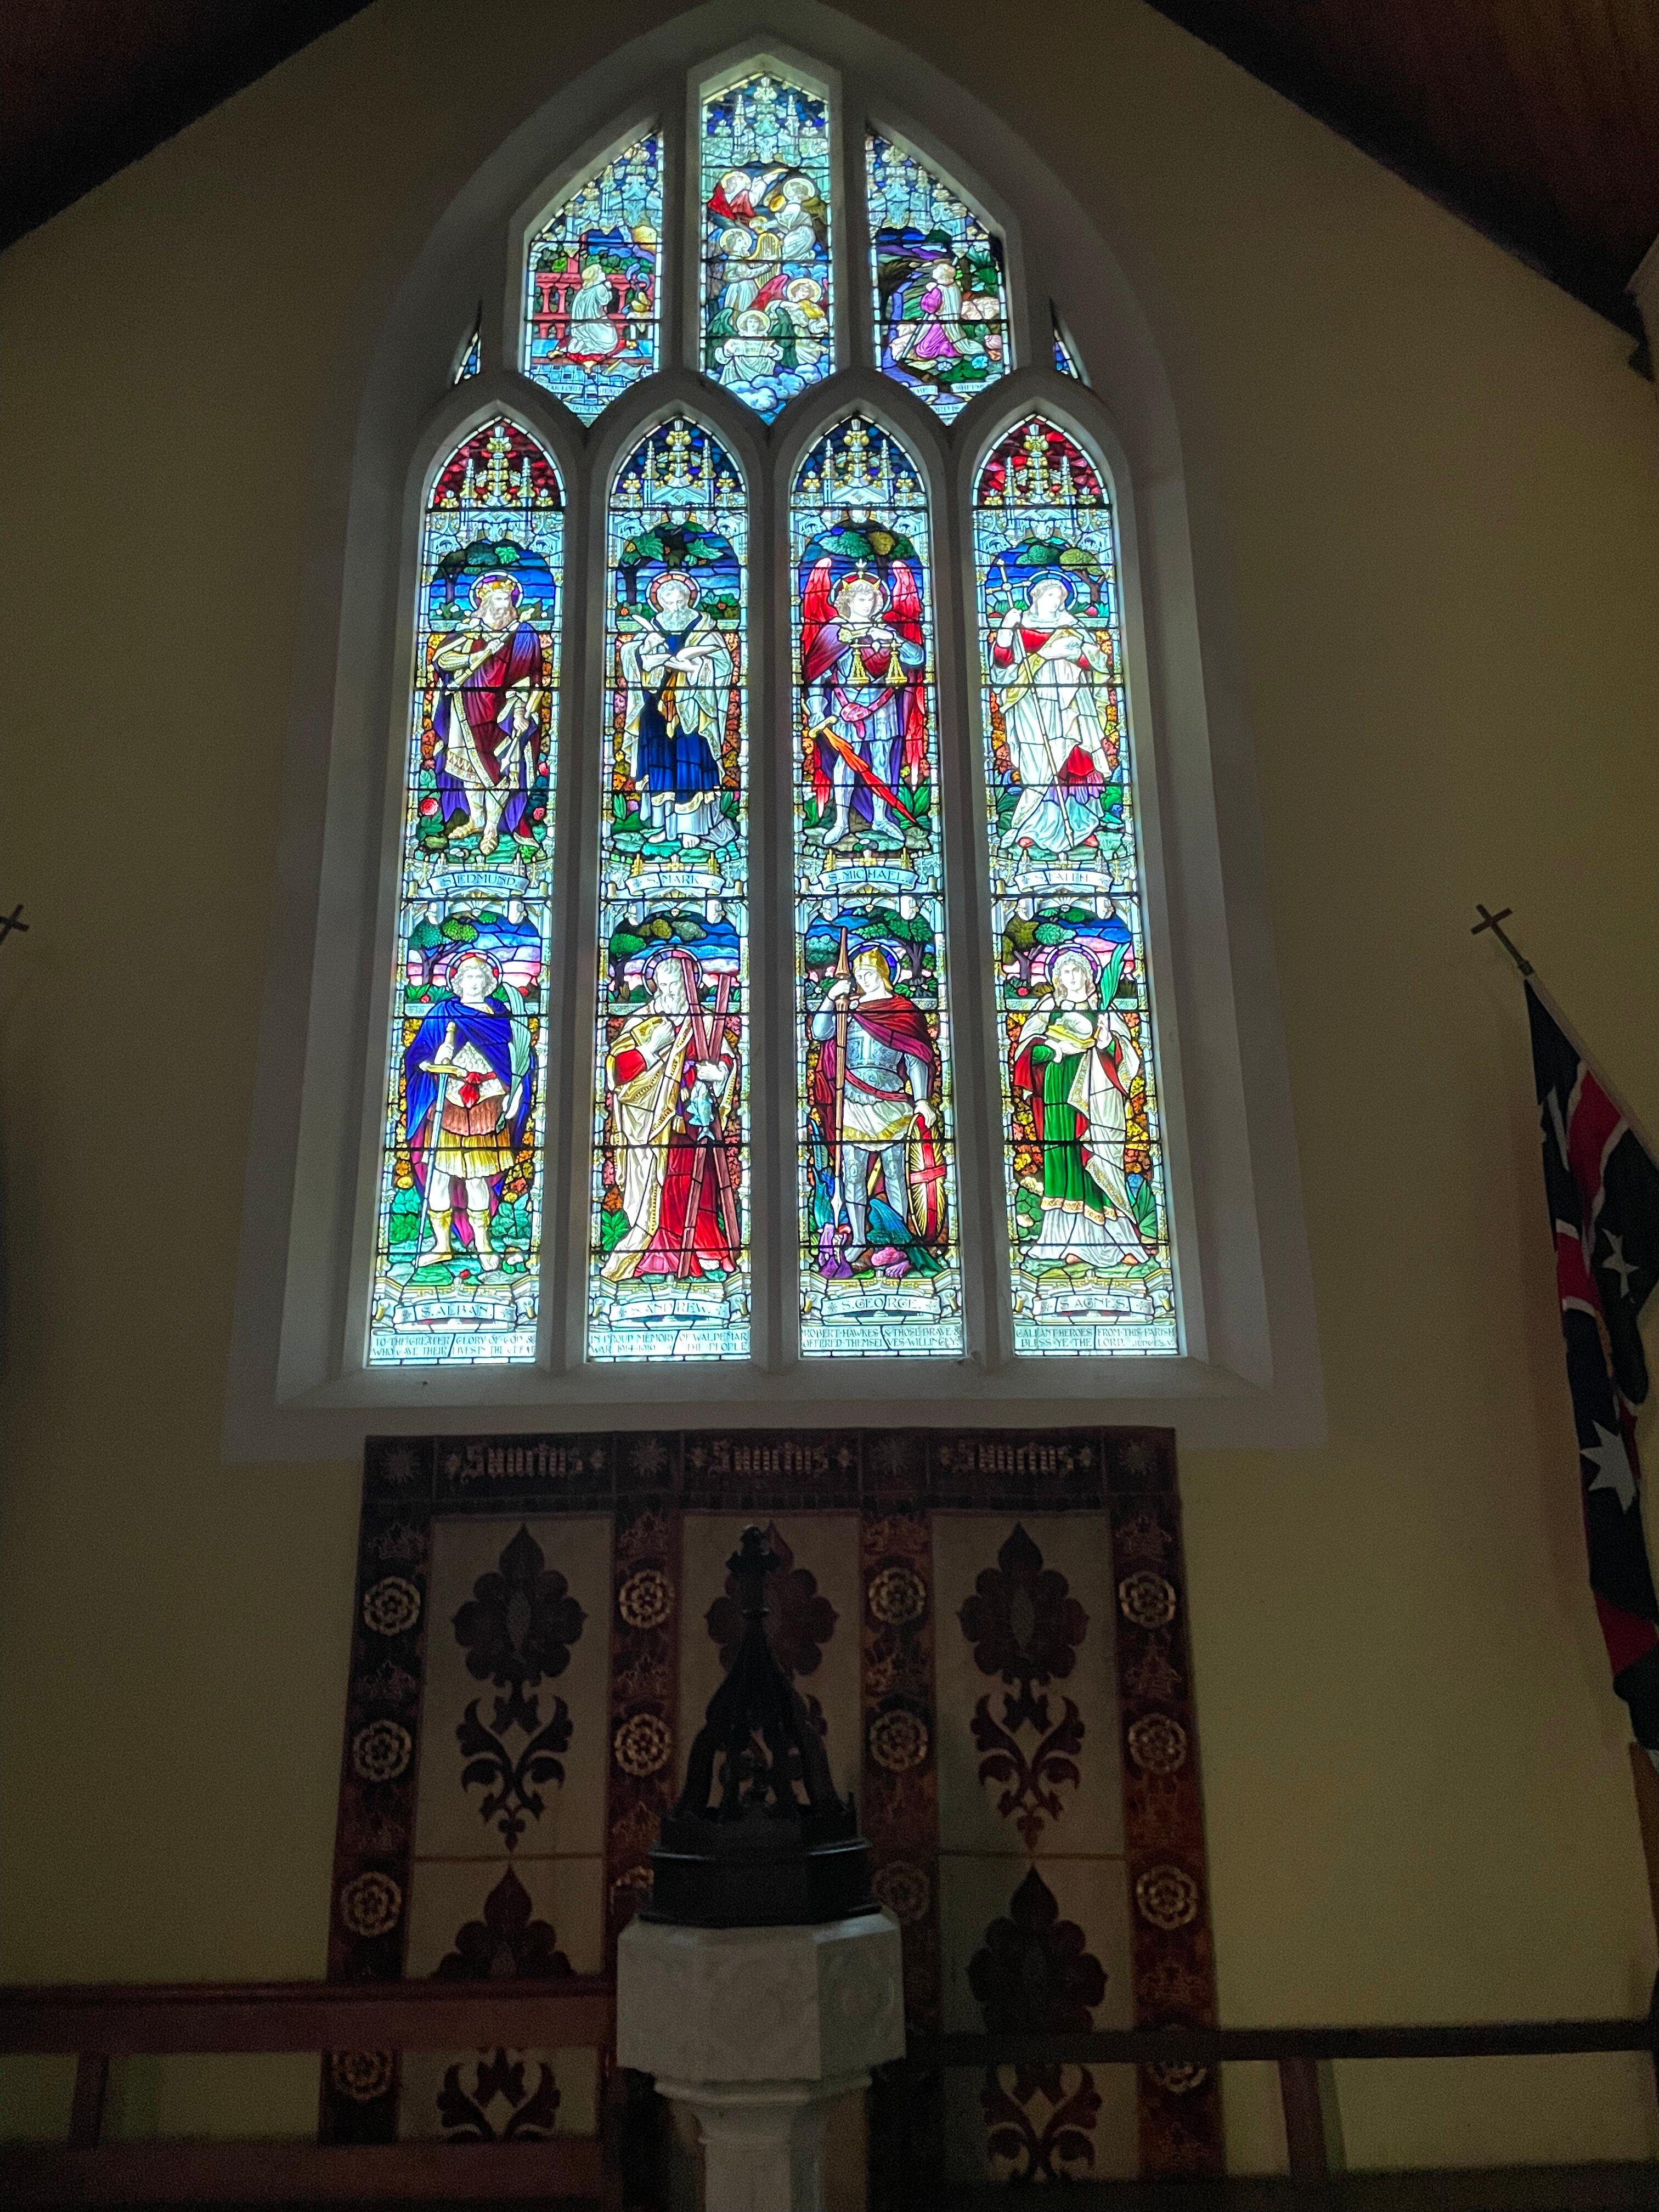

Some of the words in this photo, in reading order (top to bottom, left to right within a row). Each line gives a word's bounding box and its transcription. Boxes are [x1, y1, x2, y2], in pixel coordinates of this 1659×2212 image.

[458, 873, 518, 887] EDMUND.
[828, 873, 840, 882] S.
[842, 869, 908, 882] MICHAEL.
[645, 1302, 710, 1314] ANDREW.
[855, 1298, 921, 1310] GEORGE.
[1075, 1297, 1128, 1308] AGNES.
[436, 1305, 493, 1316] ALBAN.
[804, 1328, 839, 1338] ROBERT
[843, 1328, 879, 1337] HAWKES
[883, 1328, 891, 1337] &
[893, 1328, 919, 1336] THOSE
[923, 1327, 951, 1336] BRAVE
[953, 1327, 961, 1336] &
[1015, 1328, 1056, 1338] GALLANT
[1058, 1328, 1092, 1337] HEROES
[1097, 1328, 1120, 1337] FROM
[1122, 1328, 1142, 1336] THIS
[1144, 1327, 1175, 1336] PARISH
[376, 1337, 386, 1346] TO
[390, 1336, 405, 1345] THE
[409, 1335, 450, 1345] GREATER
[456, 1335, 486, 1345] GLORY
[526, 1335, 534, 1345] &
[591, 1335, 601, 1344] IN
[636, 1333, 675, 1342] MEMORY
[692, 1333, 748, 1341] WALDEMAR
[803, 1339, 842, 1348] OFFERED
[845, 1338, 904, 1347] THEMSELVES
[1021, 1338, 1052, 1347] BLESS
[1054, 1338, 1069, 1347] YE
[1071, 1338, 1092, 1347] THE
[373, 1347, 395, 1356] WHO
[421, 1346, 449, 1356] THEIR
[490, 1345, 503, 1355] THE
[708, 1342, 748, 1351] PEOPLE
